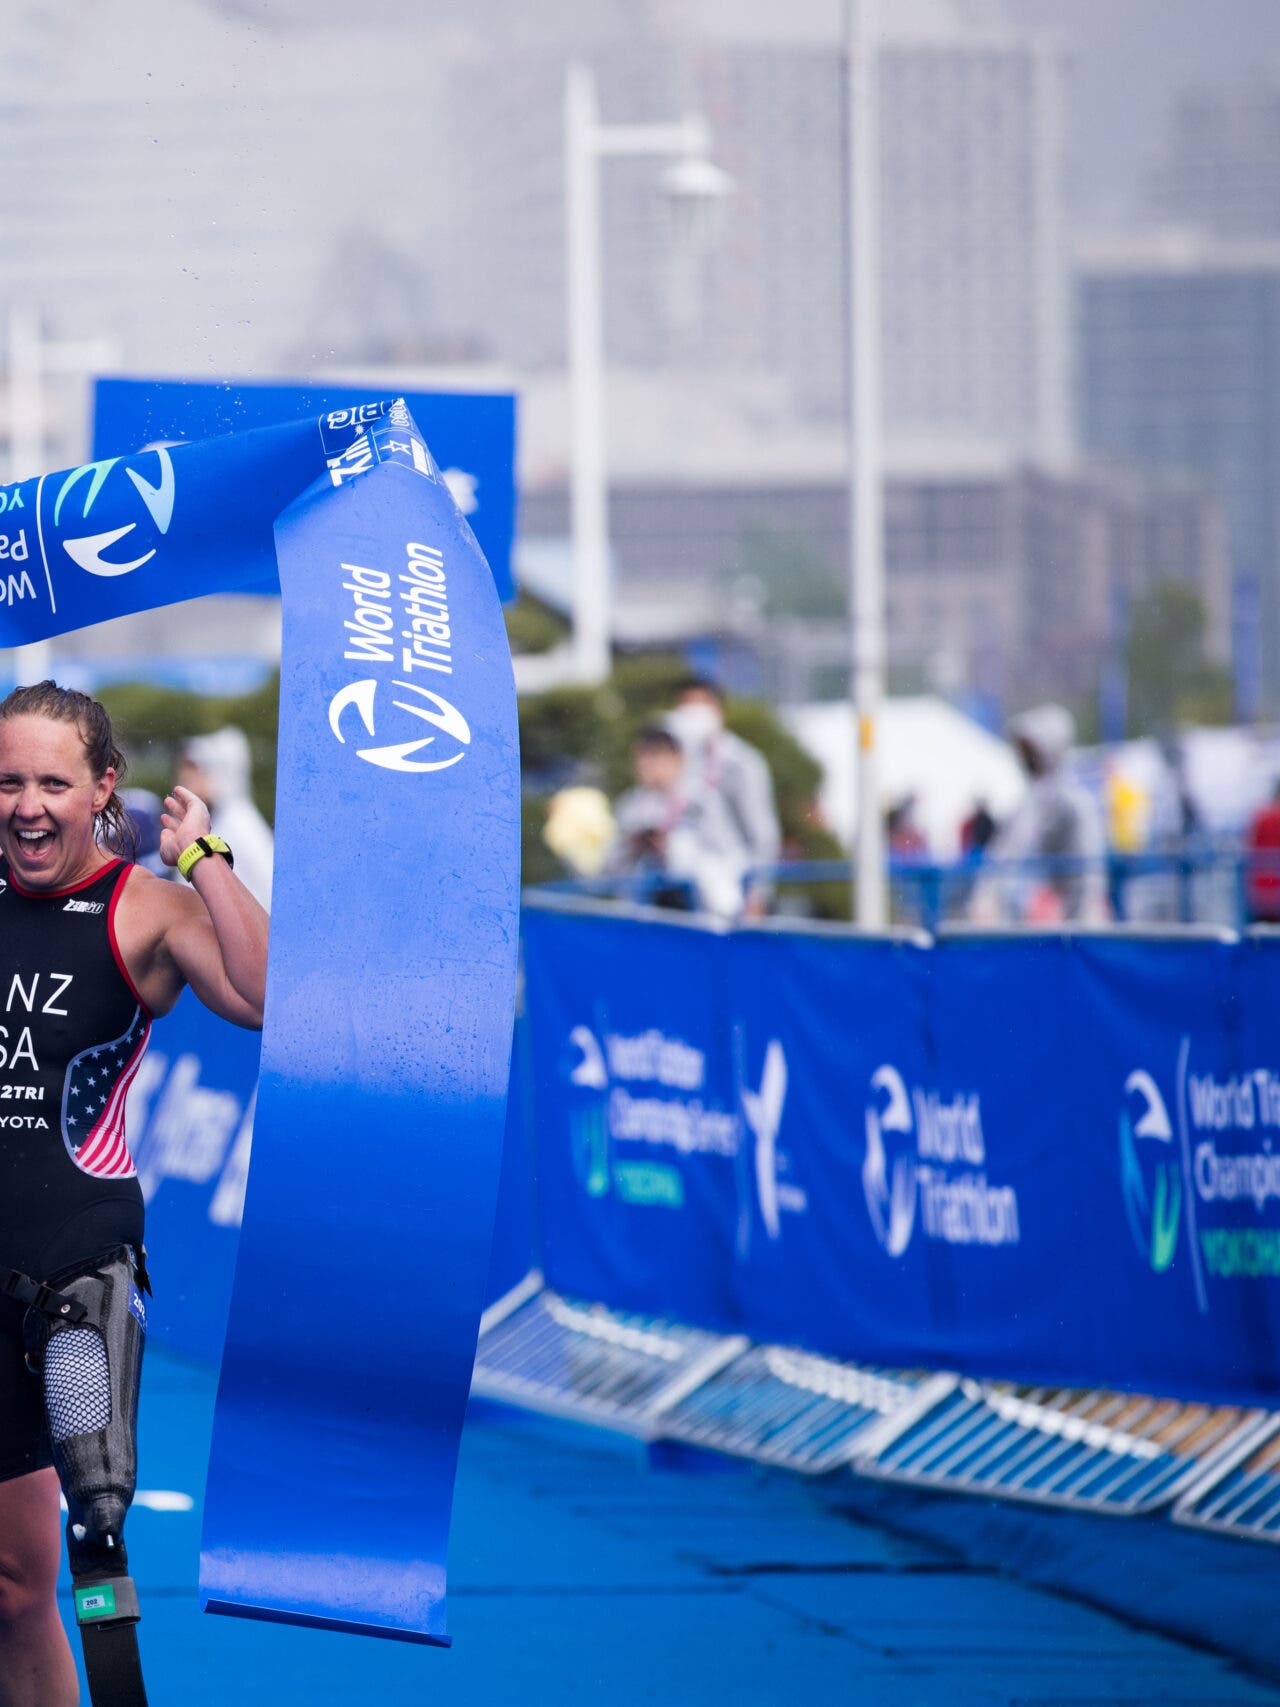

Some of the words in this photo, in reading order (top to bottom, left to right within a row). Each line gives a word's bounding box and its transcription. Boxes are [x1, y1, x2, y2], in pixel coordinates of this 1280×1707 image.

[341, 563, 395, 664] World
[400, 542, 453, 674] Triathlon
[912, 1085, 985, 1165] World
[1188, 1072, 1255, 1130] World
[916, 1164, 1020, 1245] Triathlon
[85, 1598, 99, 1606] 202
